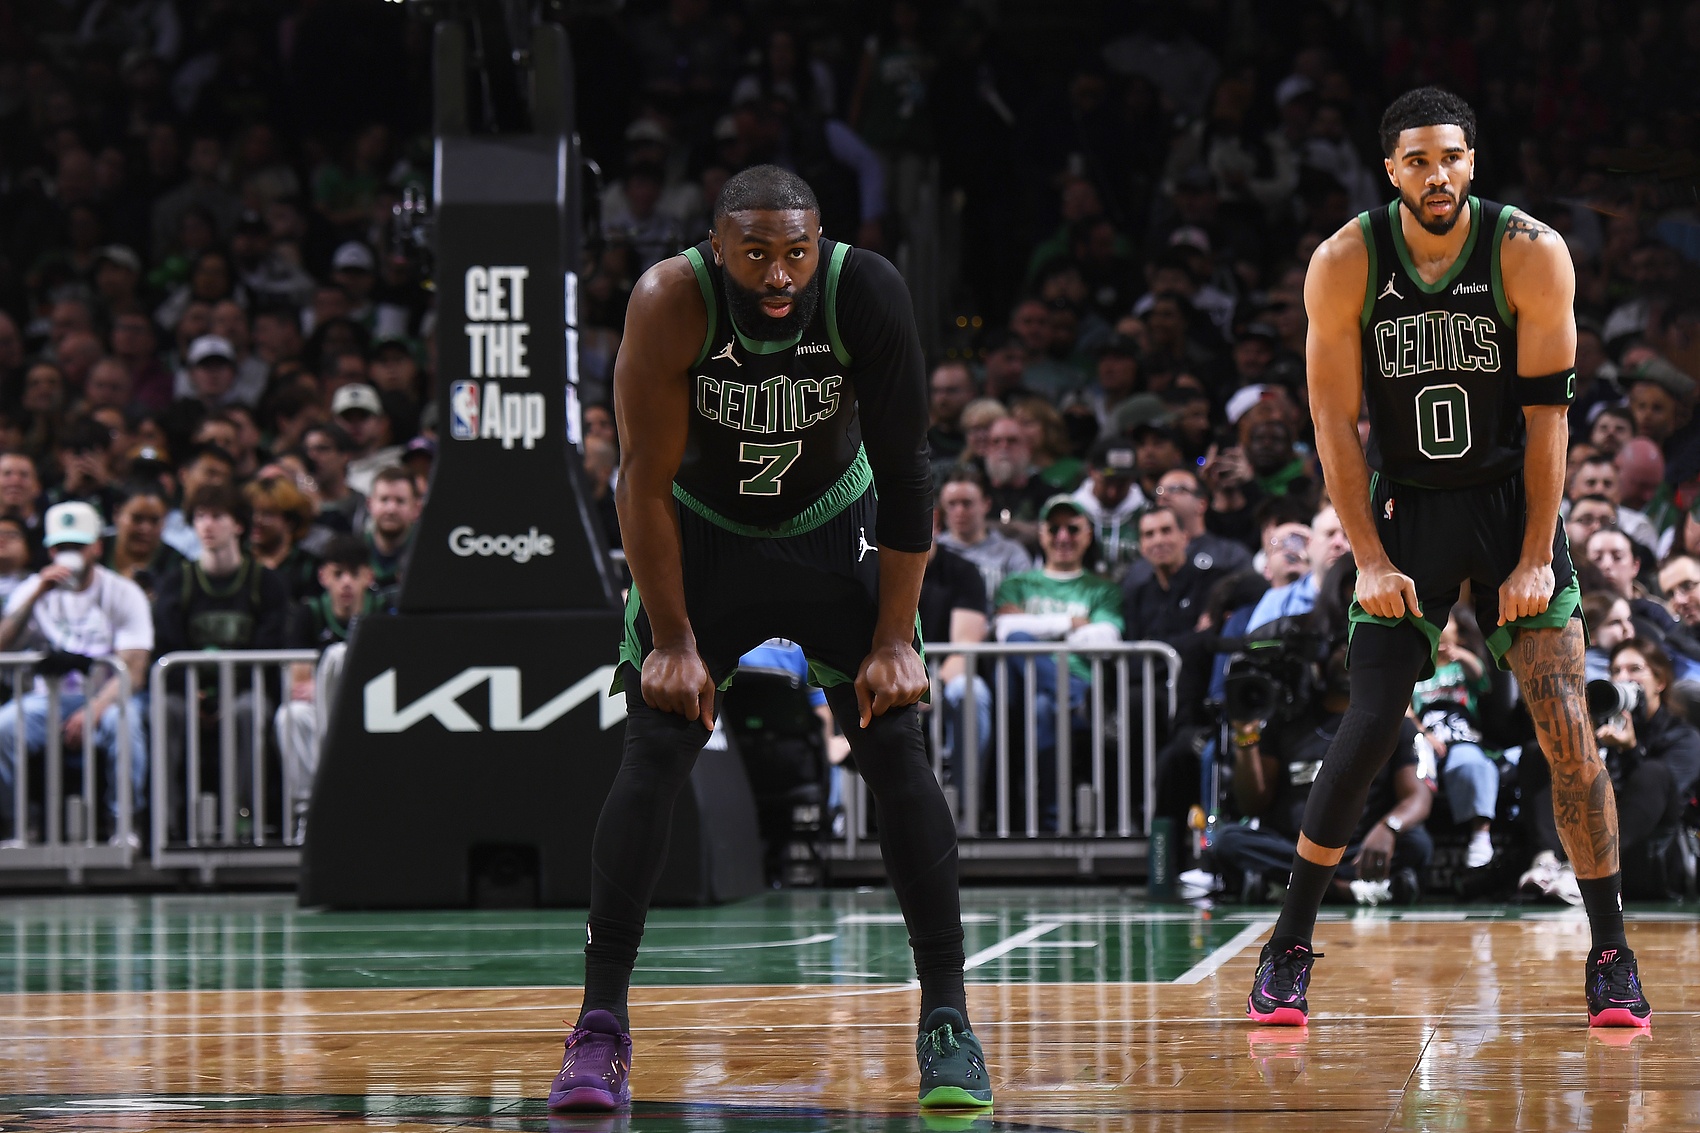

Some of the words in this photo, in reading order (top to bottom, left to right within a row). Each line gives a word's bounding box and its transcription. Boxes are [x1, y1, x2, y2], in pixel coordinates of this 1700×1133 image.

[465, 266, 528, 320] GET
[1452, 282, 1488, 295] Amica
[465, 324, 530, 377] THE
[1374, 310, 1501, 378] CELTICS
[482, 382, 545, 449] App
[697, 375, 842, 434] CELTICS
[1415, 383, 1472, 459] 0
[739, 440, 802, 495] 7
[449, 526, 555, 562] Google
